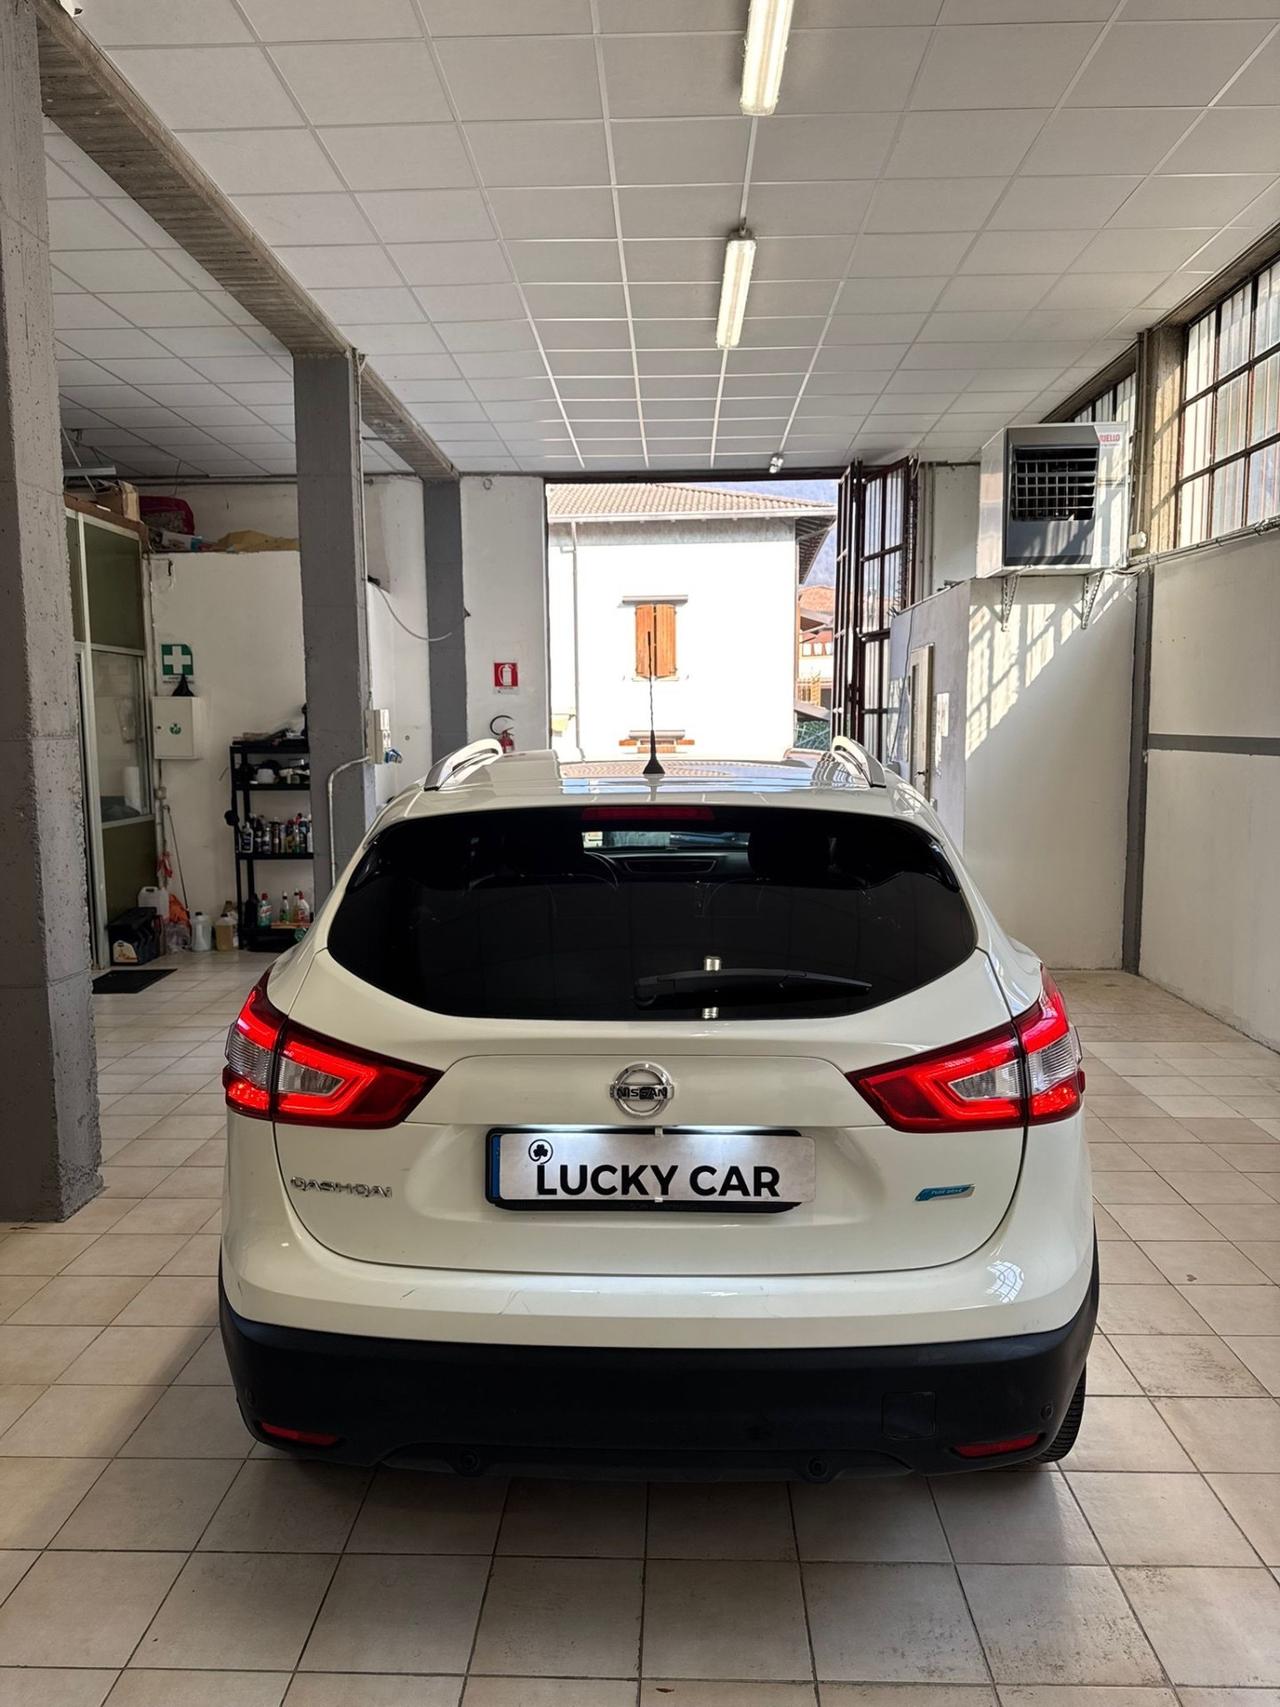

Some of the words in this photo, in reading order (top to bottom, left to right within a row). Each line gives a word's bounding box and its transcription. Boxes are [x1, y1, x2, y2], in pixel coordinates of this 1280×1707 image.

[616, 1086, 667, 1099] NISSAN
[290, 1176, 392, 1198] QASHQAI
[536, 1164, 678, 1196] LUCKY
[689, 1165, 780, 1197] CAR
